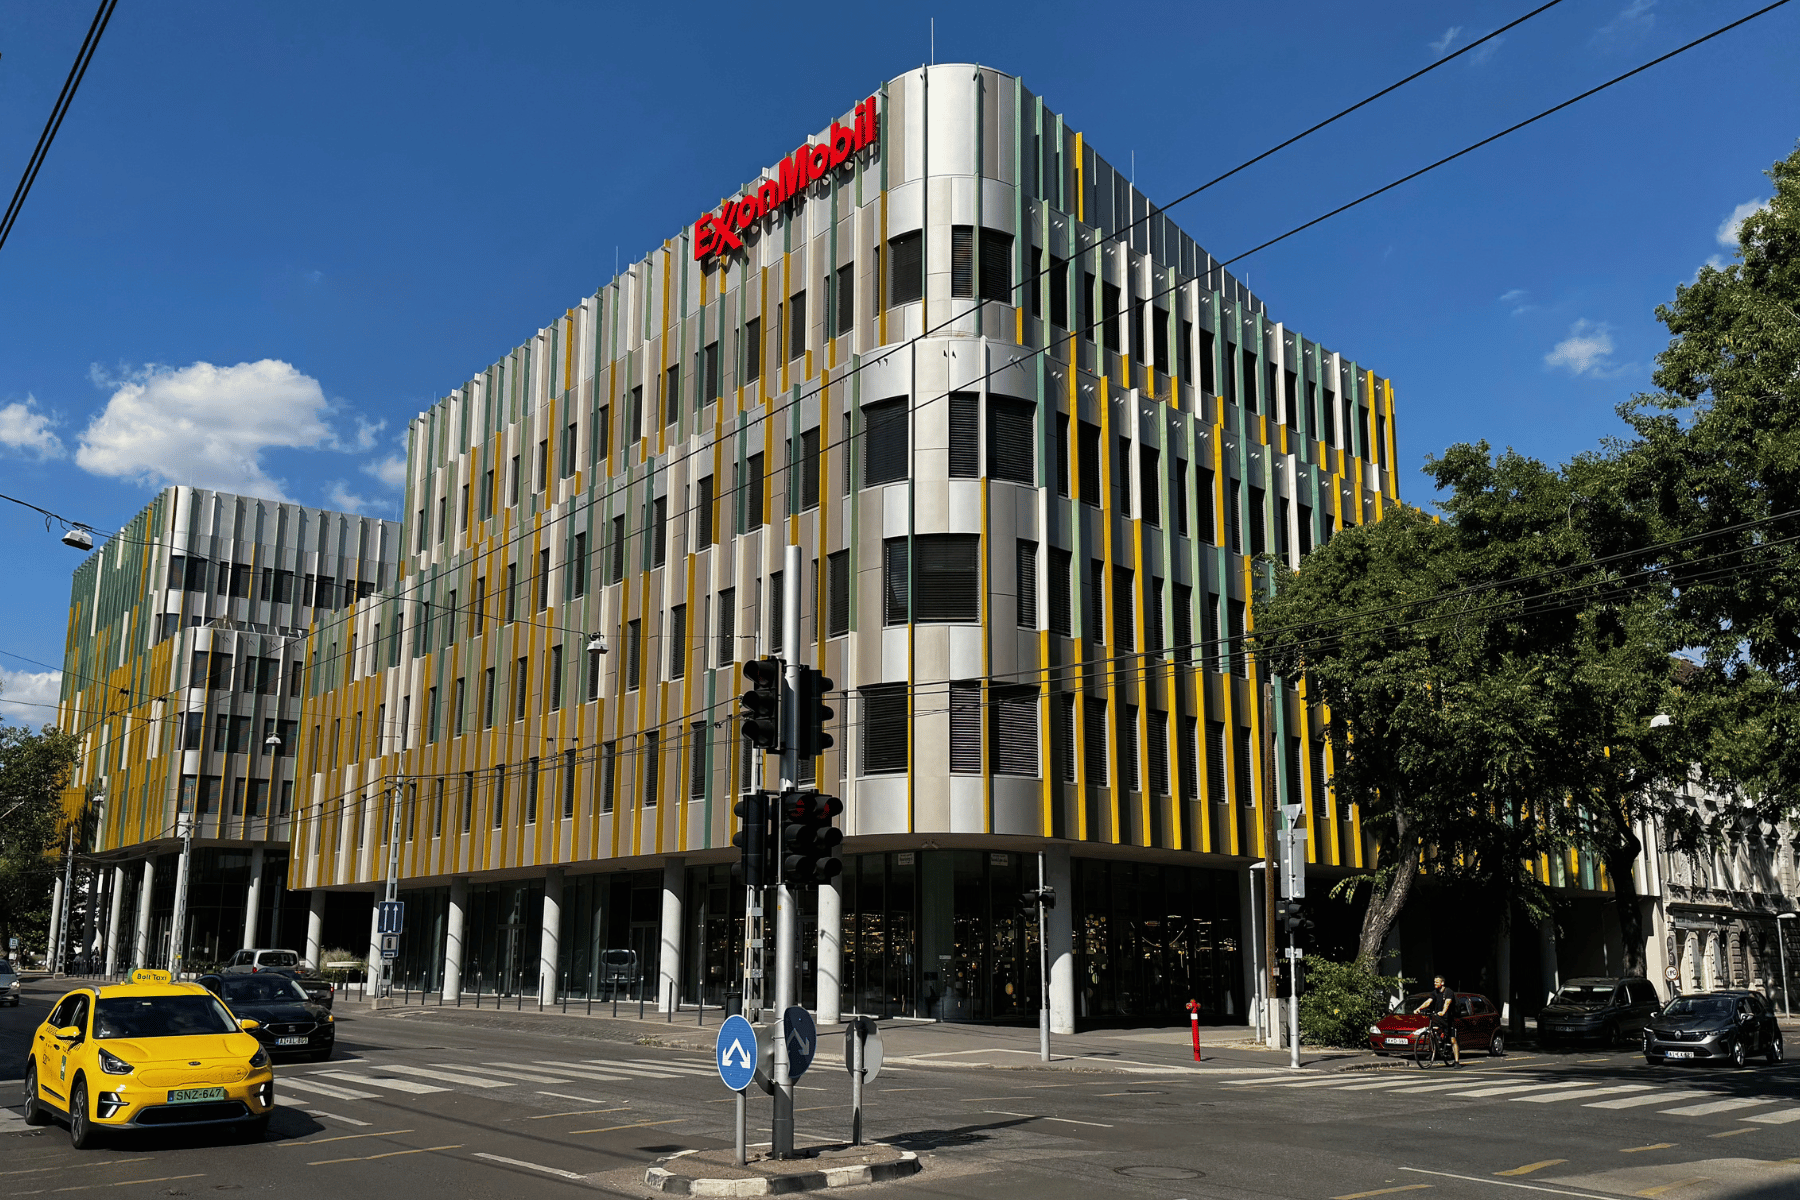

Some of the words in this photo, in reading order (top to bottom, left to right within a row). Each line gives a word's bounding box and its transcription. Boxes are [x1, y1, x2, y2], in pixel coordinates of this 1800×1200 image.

[694, 96, 877, 261] ExxonMobil
[137, 973, 151, 981] Bolt
[153, 973, 167, 981] Taxi
[176, 1088, 222, 1101] SNZ-647
